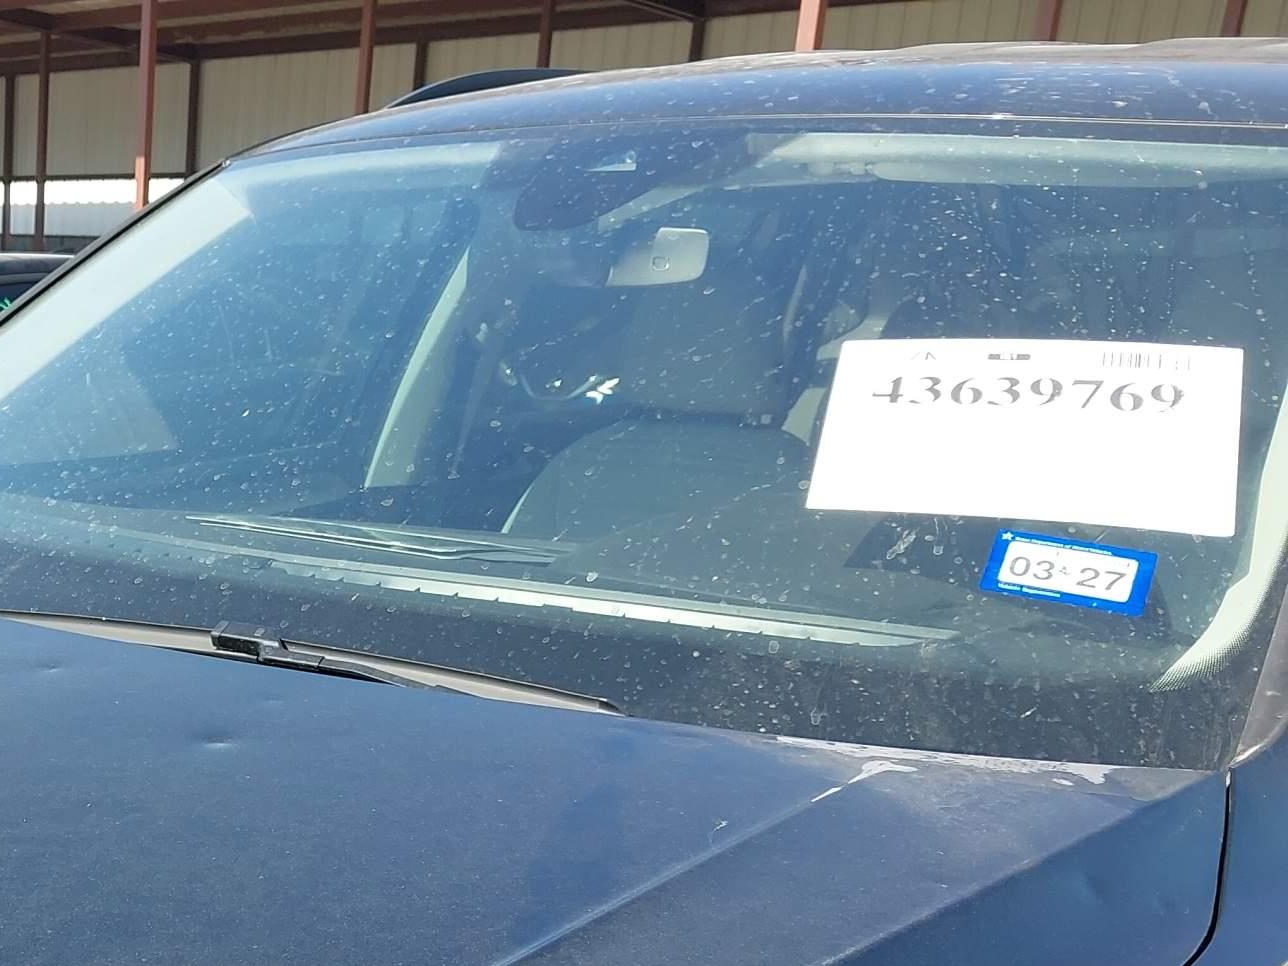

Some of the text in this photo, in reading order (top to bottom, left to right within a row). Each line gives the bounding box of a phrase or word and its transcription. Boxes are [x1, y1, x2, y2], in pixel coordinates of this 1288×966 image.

[872, 376, 1186, 413] 43639769
[1009, 556, 1056, 581] 03
[1076, 567, 1128, 592] 27
